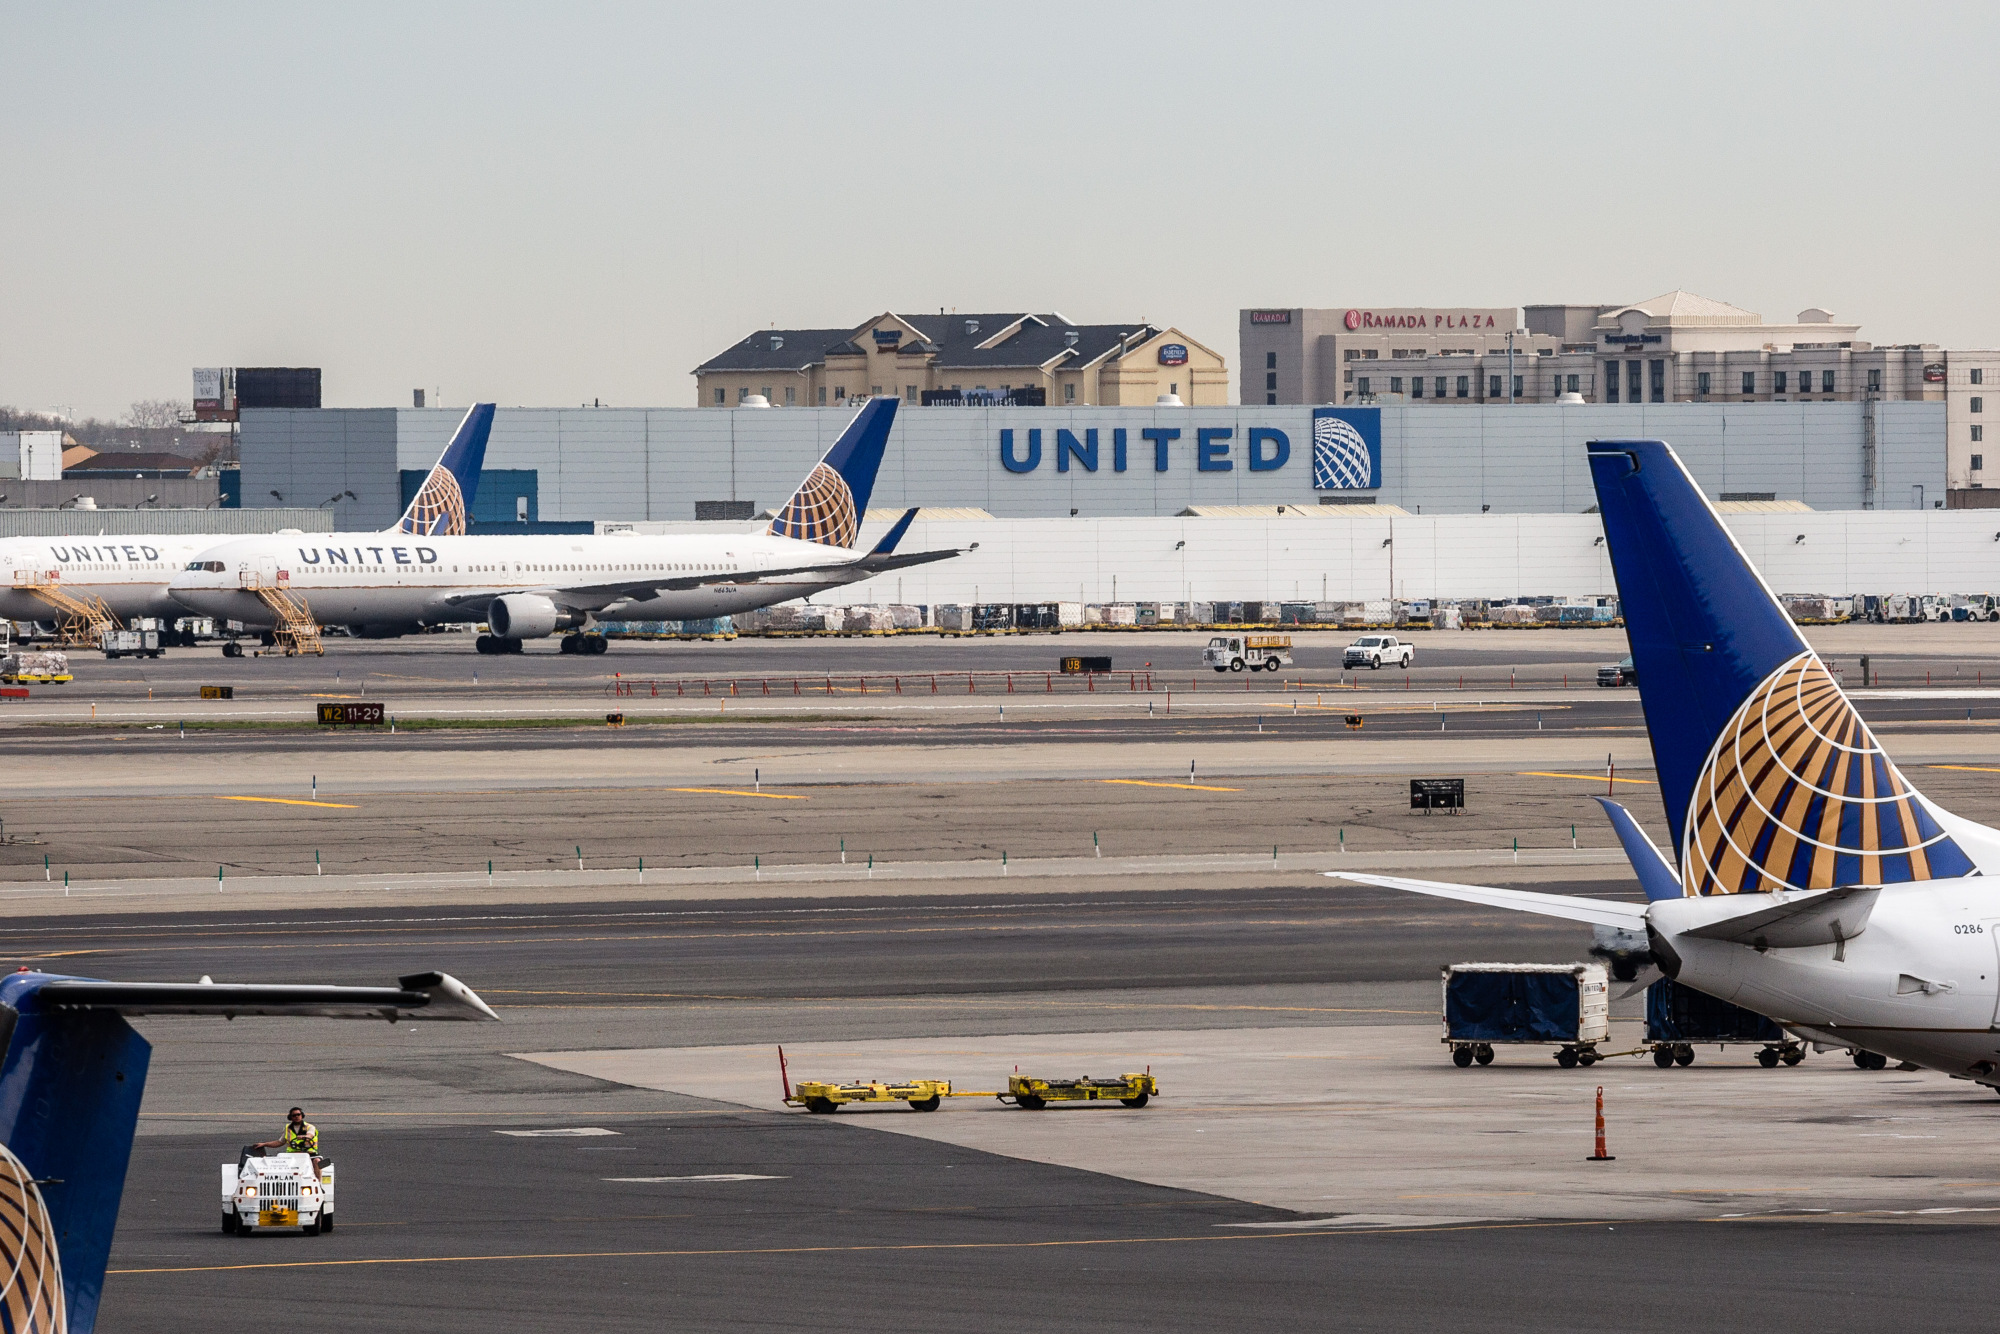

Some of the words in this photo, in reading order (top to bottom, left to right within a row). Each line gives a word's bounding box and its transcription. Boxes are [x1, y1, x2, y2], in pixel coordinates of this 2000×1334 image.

[1253, 311, 1287, 322] RAMADA
[1363, 311, 1427, 328] RAMADA
[1435, 314, 1495, 328] PLAZA
[1000, 427, 1291, 473] UNITED
[50, 545, 159, 563] UNITED
[298, 546, 438, 565] UNITED
[1067, 660, 1080, 670] UB
[323, 707, 342, 720] W2
[347, 707, 380, 720] 11-29
[1954, 924, 1983, 935] 0286
